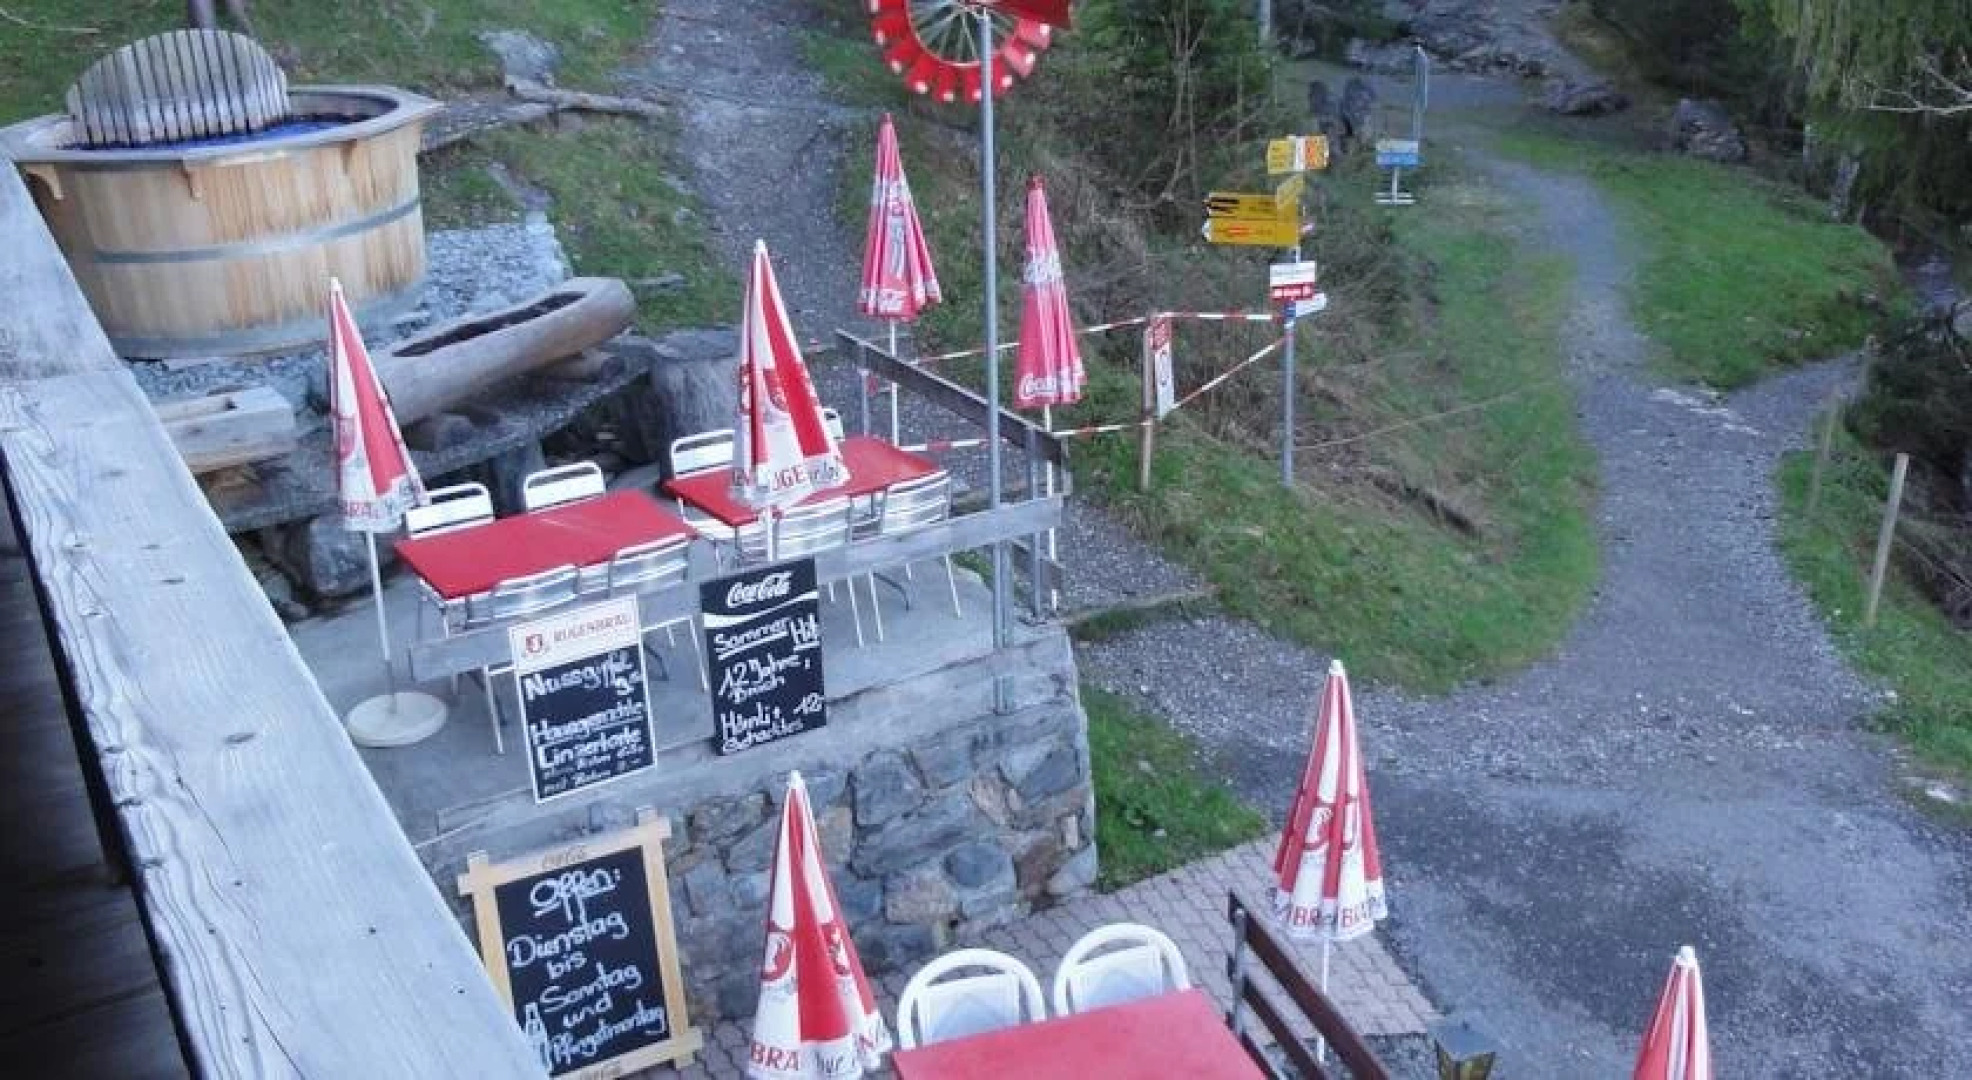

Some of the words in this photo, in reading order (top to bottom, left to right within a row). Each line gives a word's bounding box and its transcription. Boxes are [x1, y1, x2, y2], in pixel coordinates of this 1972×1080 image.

[726, 570, 792, 608] Coca-Cola
[530, 868, 621, 924] Offen:
[507, 911, 630, 967] Dienstag
[540, 962, 642, 1012] Sonntag
[546, 951, 588, 979] bis
[563, 992, 613, 1028] und
